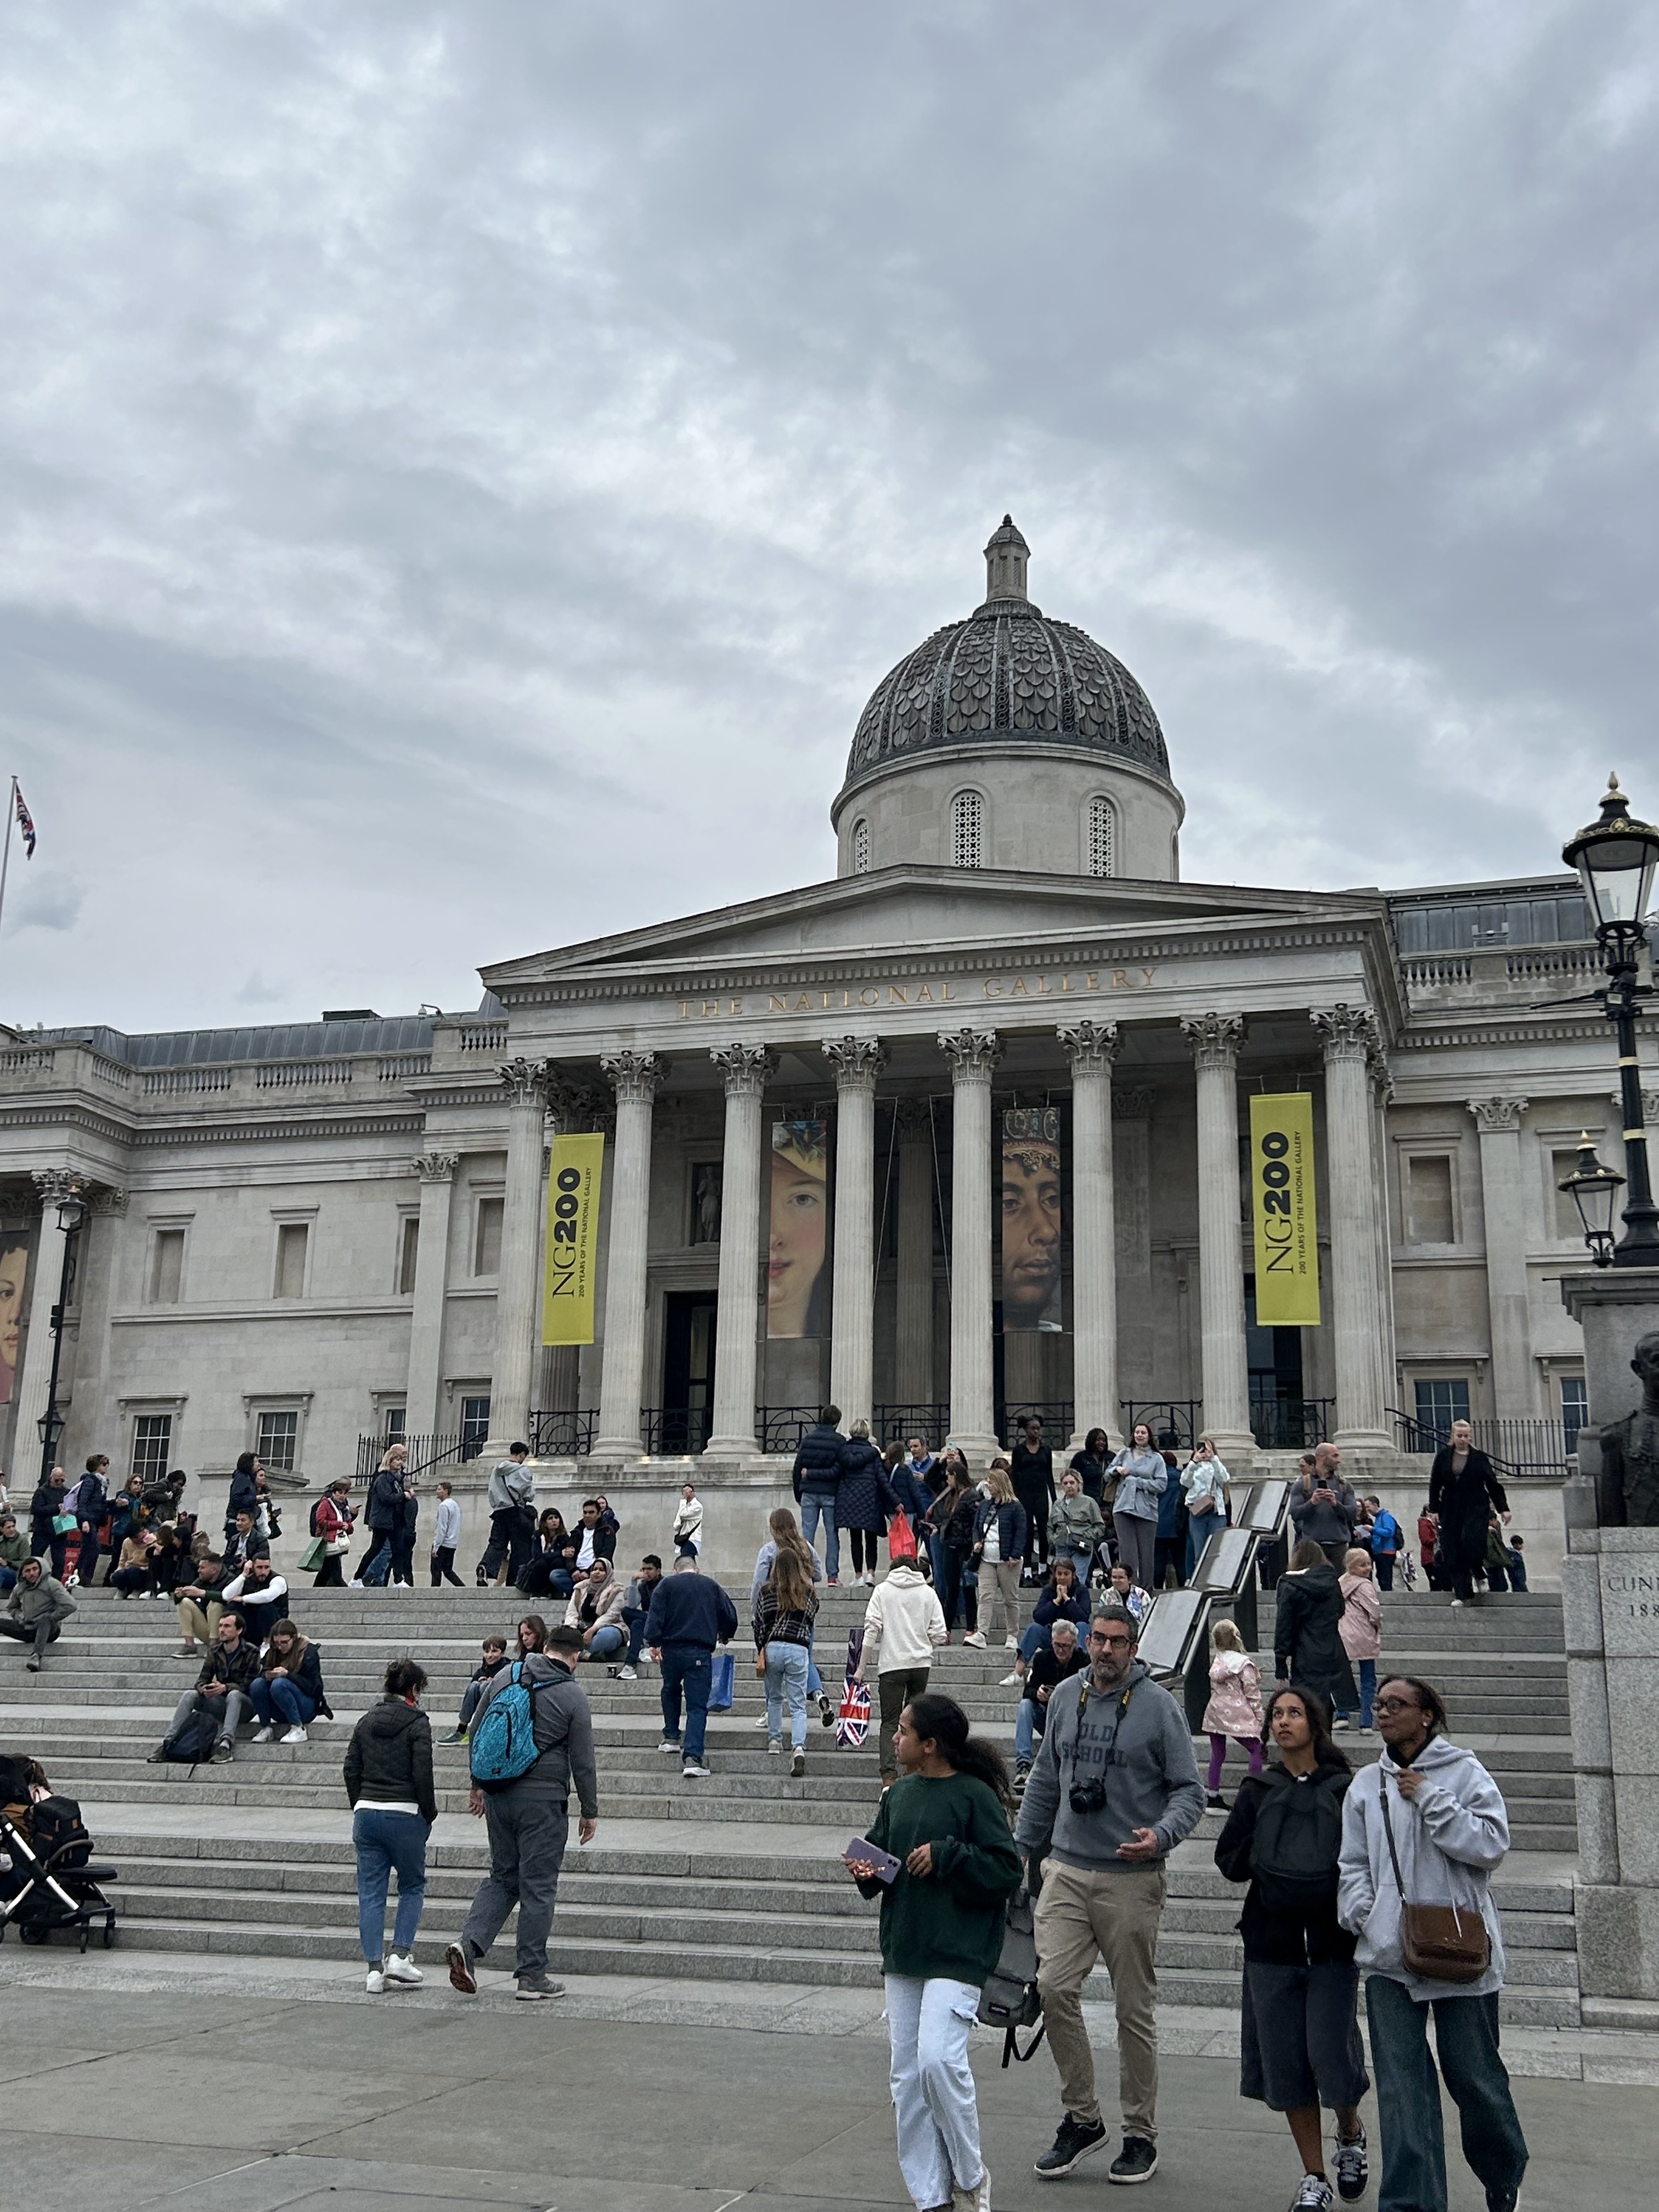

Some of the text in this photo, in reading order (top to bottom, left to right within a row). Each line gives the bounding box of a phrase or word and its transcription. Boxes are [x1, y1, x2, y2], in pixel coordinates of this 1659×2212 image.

[676, 967, 1159, 1019] THE NATIONAL GALLERY
[1293, 1131, 1302, 1164] GALLERY
[1261, 1131, 1294, 1274] NG200
[1294, 1165, 1304, 1204] NATIONAL
[580, 1248, 586, 1259] OF
[584, 1167, 592, 1197] GALLERY
[1297, 1222, 1305, 1233] OF
[552, 1167, 581, 1299] NG200
[1297, 1234, 1306, 1260] YEARS
[1607, 1576, 1659, 1592] CUN
[1079, 1723, 1114, 1742] OLD
